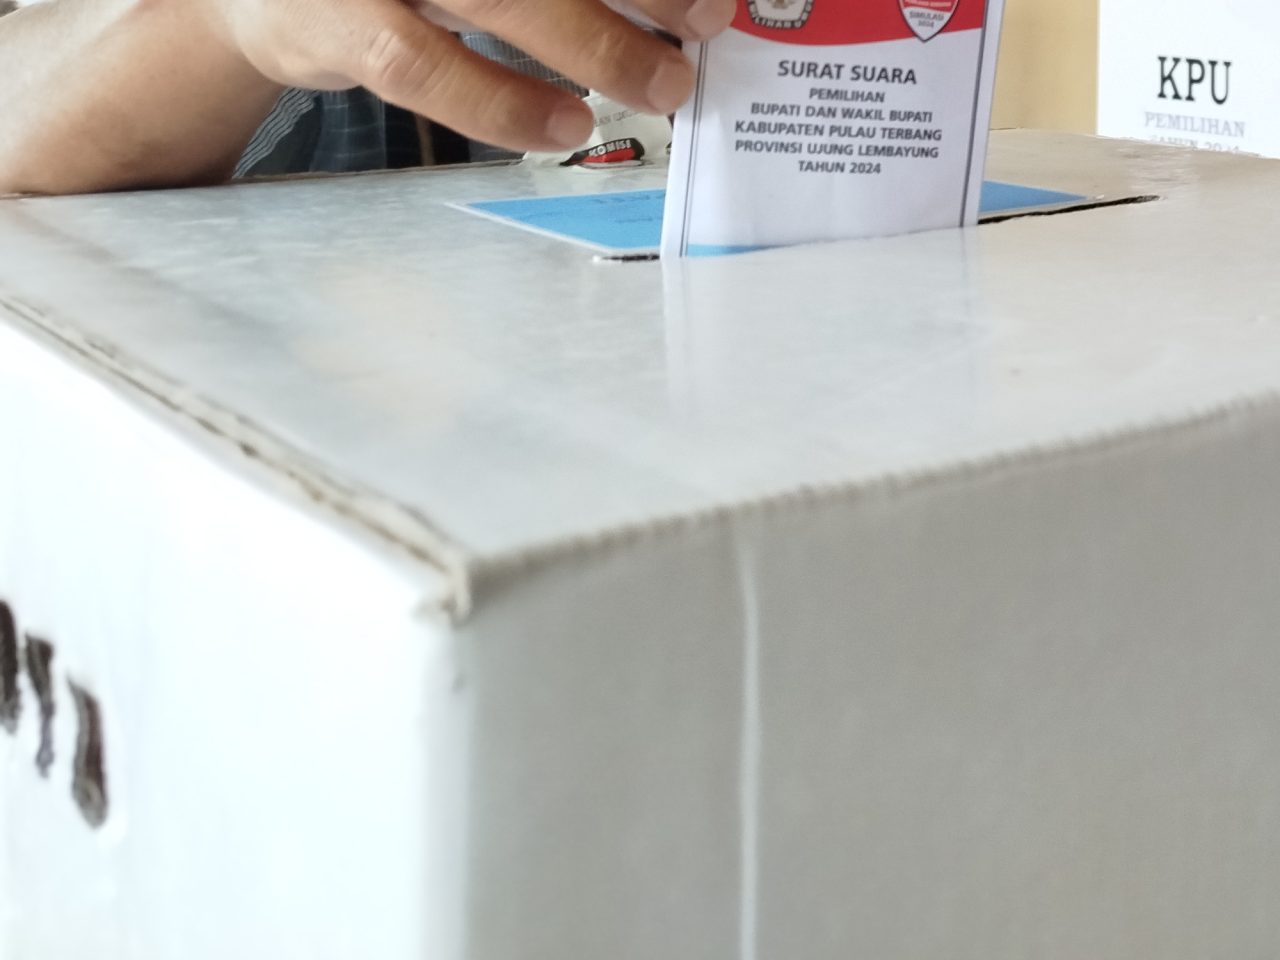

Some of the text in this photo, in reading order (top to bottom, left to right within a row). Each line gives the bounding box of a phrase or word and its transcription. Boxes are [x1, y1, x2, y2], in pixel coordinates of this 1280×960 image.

[777, 59, 917, 85] SURAT SUARA
[1157, 55, 1232, 105] KPU
[808, 87, 886, 103] PEMILIHAN
[750, 102, 933, 123] BUPATI DAN WAKIL BUPATI
[735, 120, 942, 141] KABUPATEN PULAU TERBANG
[1143, 111, 1246, 139] PEMILIHAN
[588, 139, 631, 157] KOMISI
[735, 140, 939, 159] PROVINSI UJUNG LEMBAYUNG
[798, 160, 882, 175] TAHUN 2024
